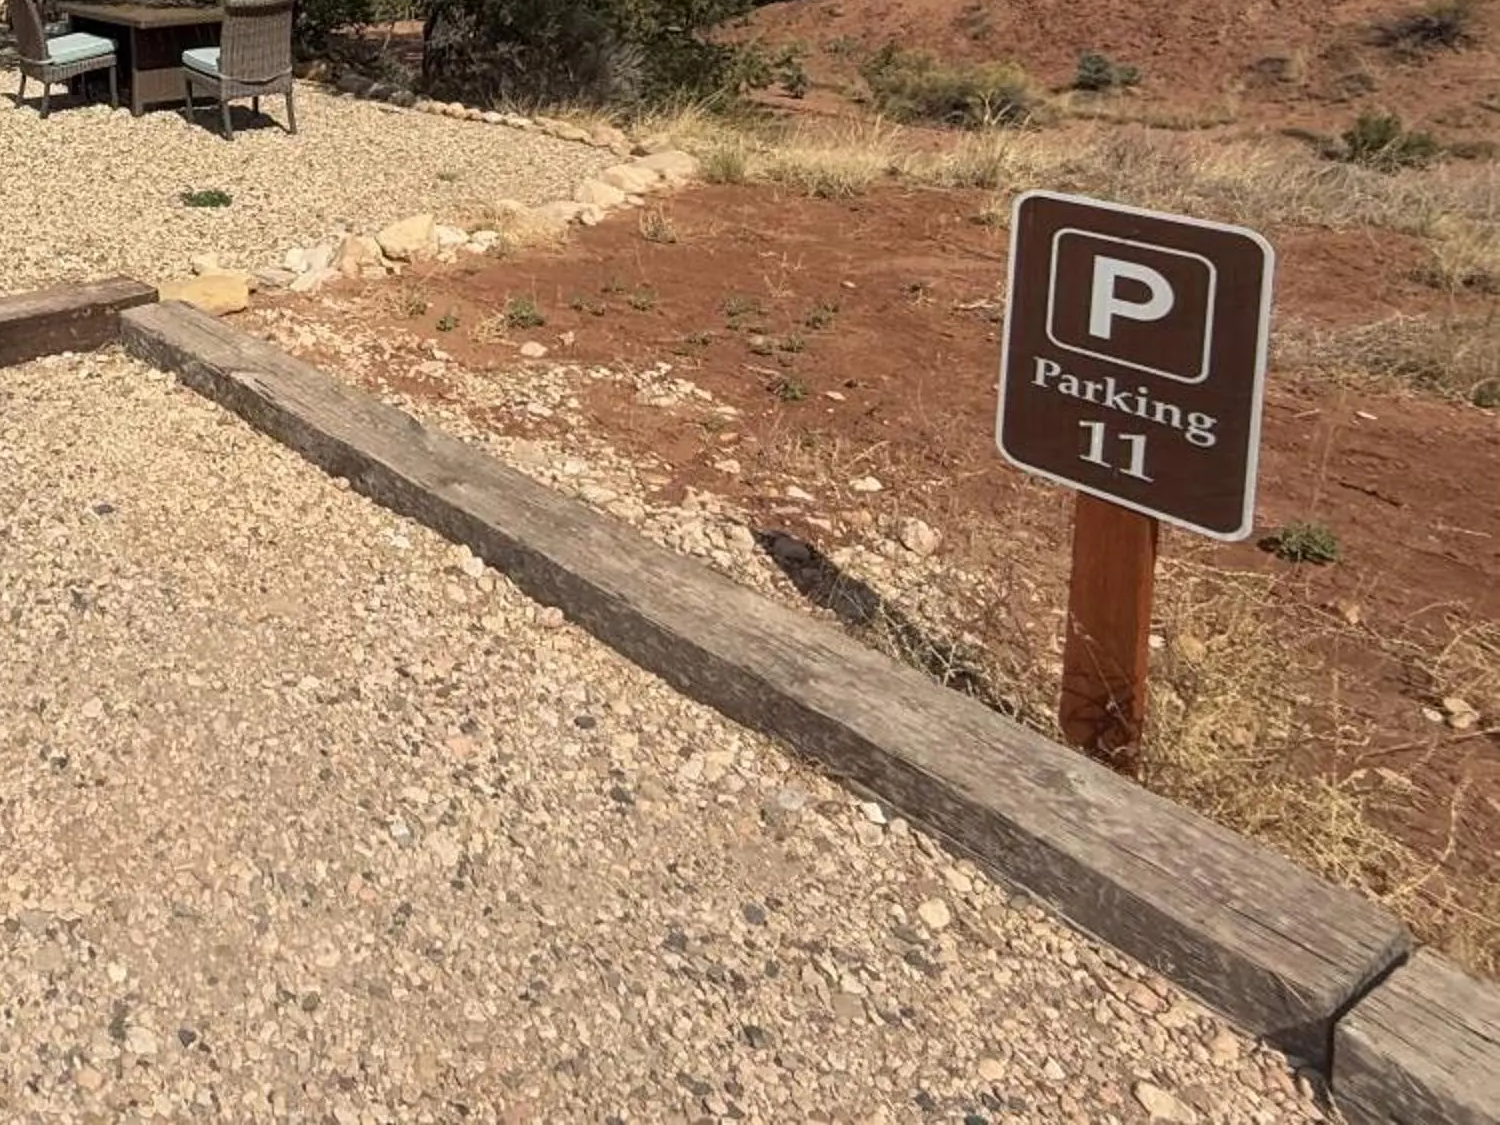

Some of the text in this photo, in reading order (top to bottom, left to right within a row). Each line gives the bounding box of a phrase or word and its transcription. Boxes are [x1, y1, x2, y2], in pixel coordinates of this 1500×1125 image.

[1089, 255, 1175, 340] P
[1031, 356, 1218, 448] Parking
[1078, 420, 1154, 483] 11
